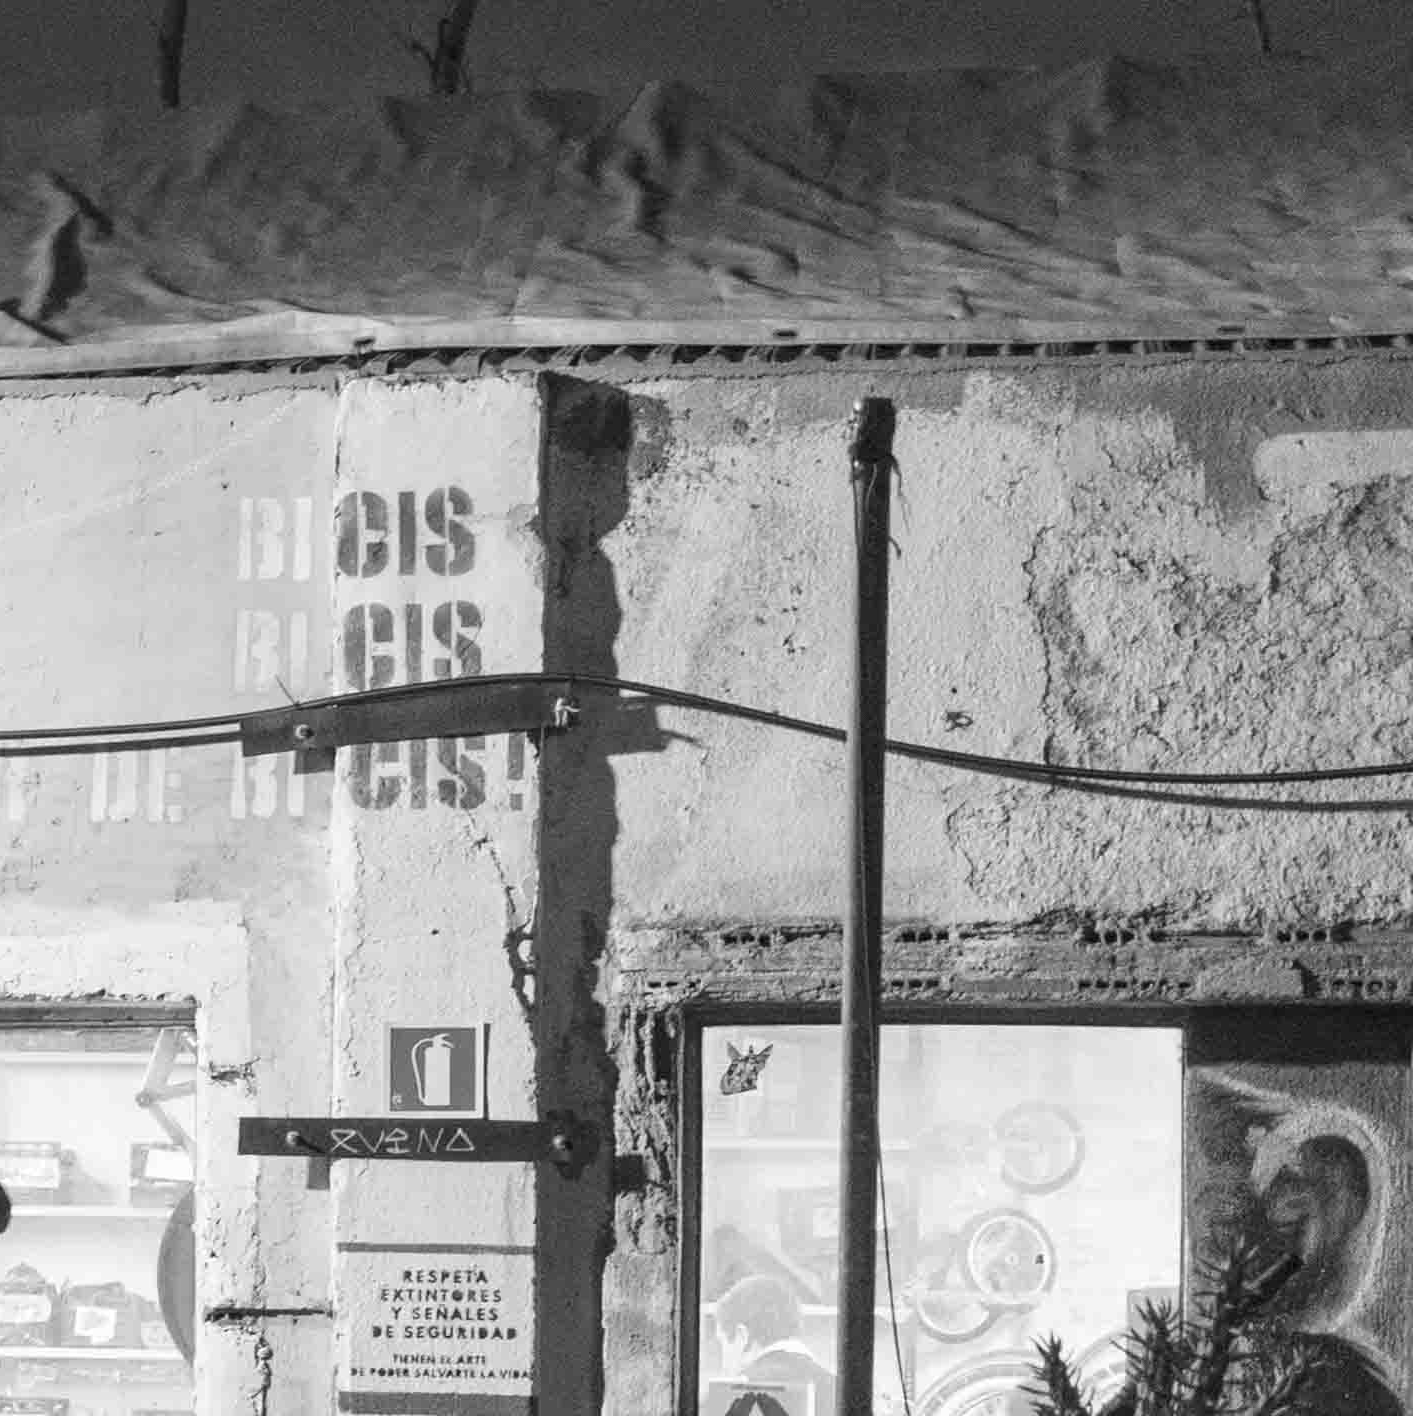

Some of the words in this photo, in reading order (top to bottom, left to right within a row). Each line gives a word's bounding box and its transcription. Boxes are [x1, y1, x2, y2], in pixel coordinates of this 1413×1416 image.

[237, 485, 476, 581] BICIS
[231, 599, 485, 694] BICIS
[403, 1270, 488, 1284] RESPETA
[380, 1289, 502, 1303] EXTINTORES
[391, 1306, 403, 1321] Y
[412, 1304, 499, 1321] SEÑALES
[372, 1326, 396, 1339] DE
[404, 1326, 518, 1340] SEGURIDAD
